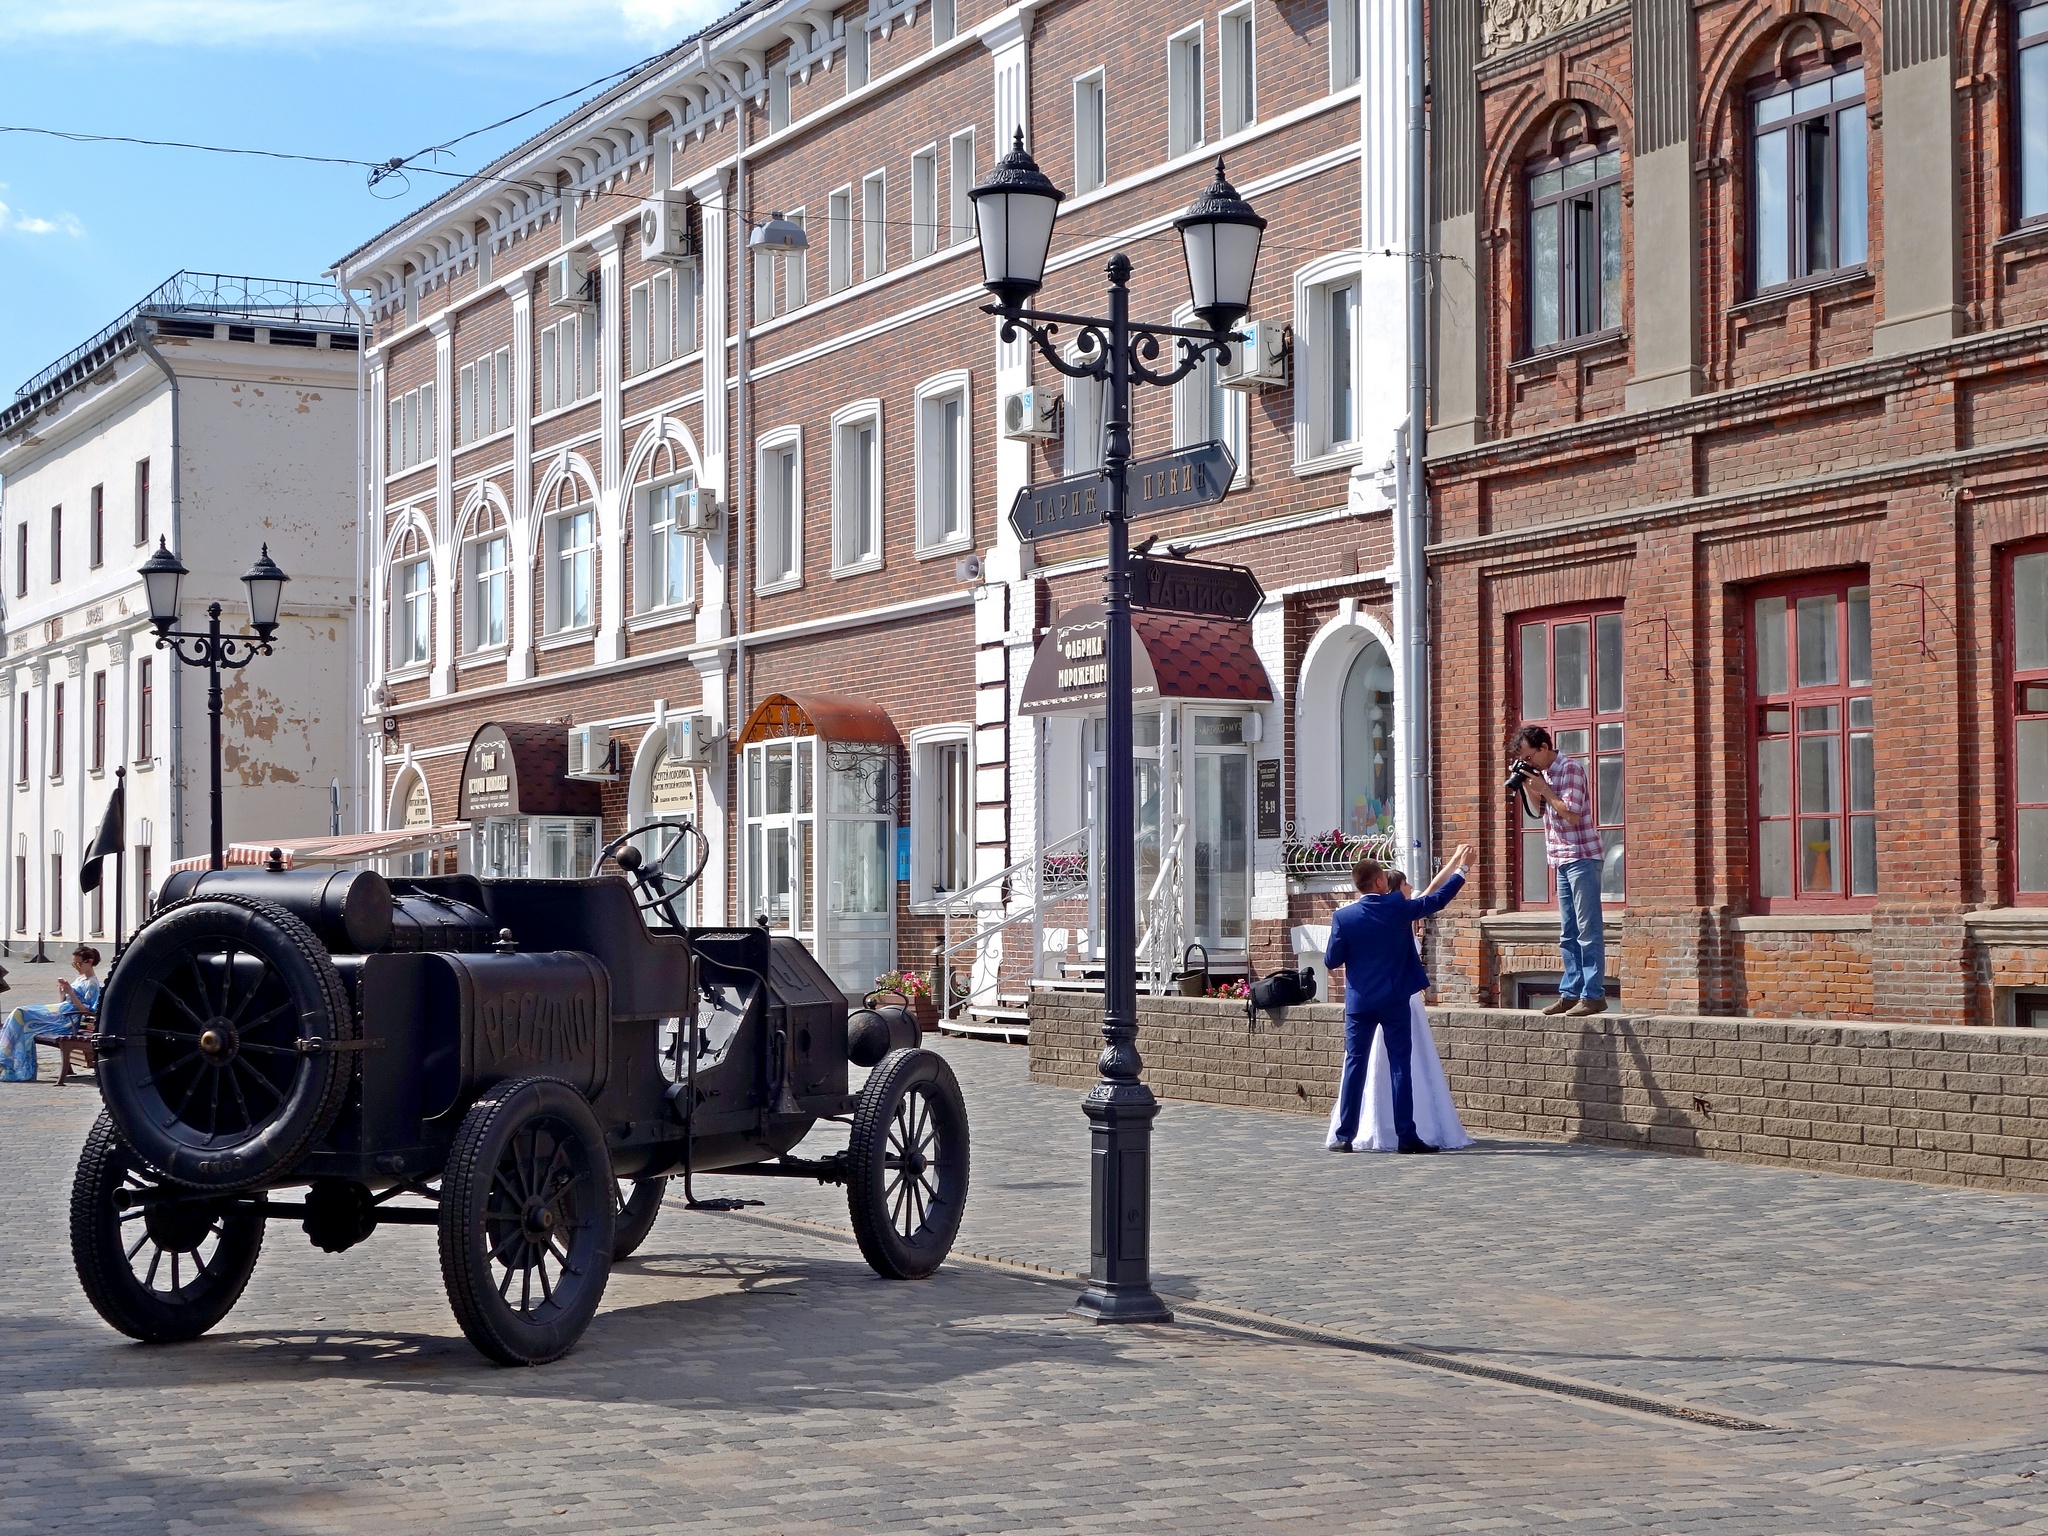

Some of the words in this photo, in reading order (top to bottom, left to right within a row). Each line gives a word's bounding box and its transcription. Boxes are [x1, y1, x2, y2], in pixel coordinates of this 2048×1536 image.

[1142, 461, 1207, 501] ПЕКИН
[1034, 488, 1098, 525] ПАРИЖ
[1159, 577, 1237, 612] АРТИКО
[1065, 636, 1102, 659] ФАБРИКА
